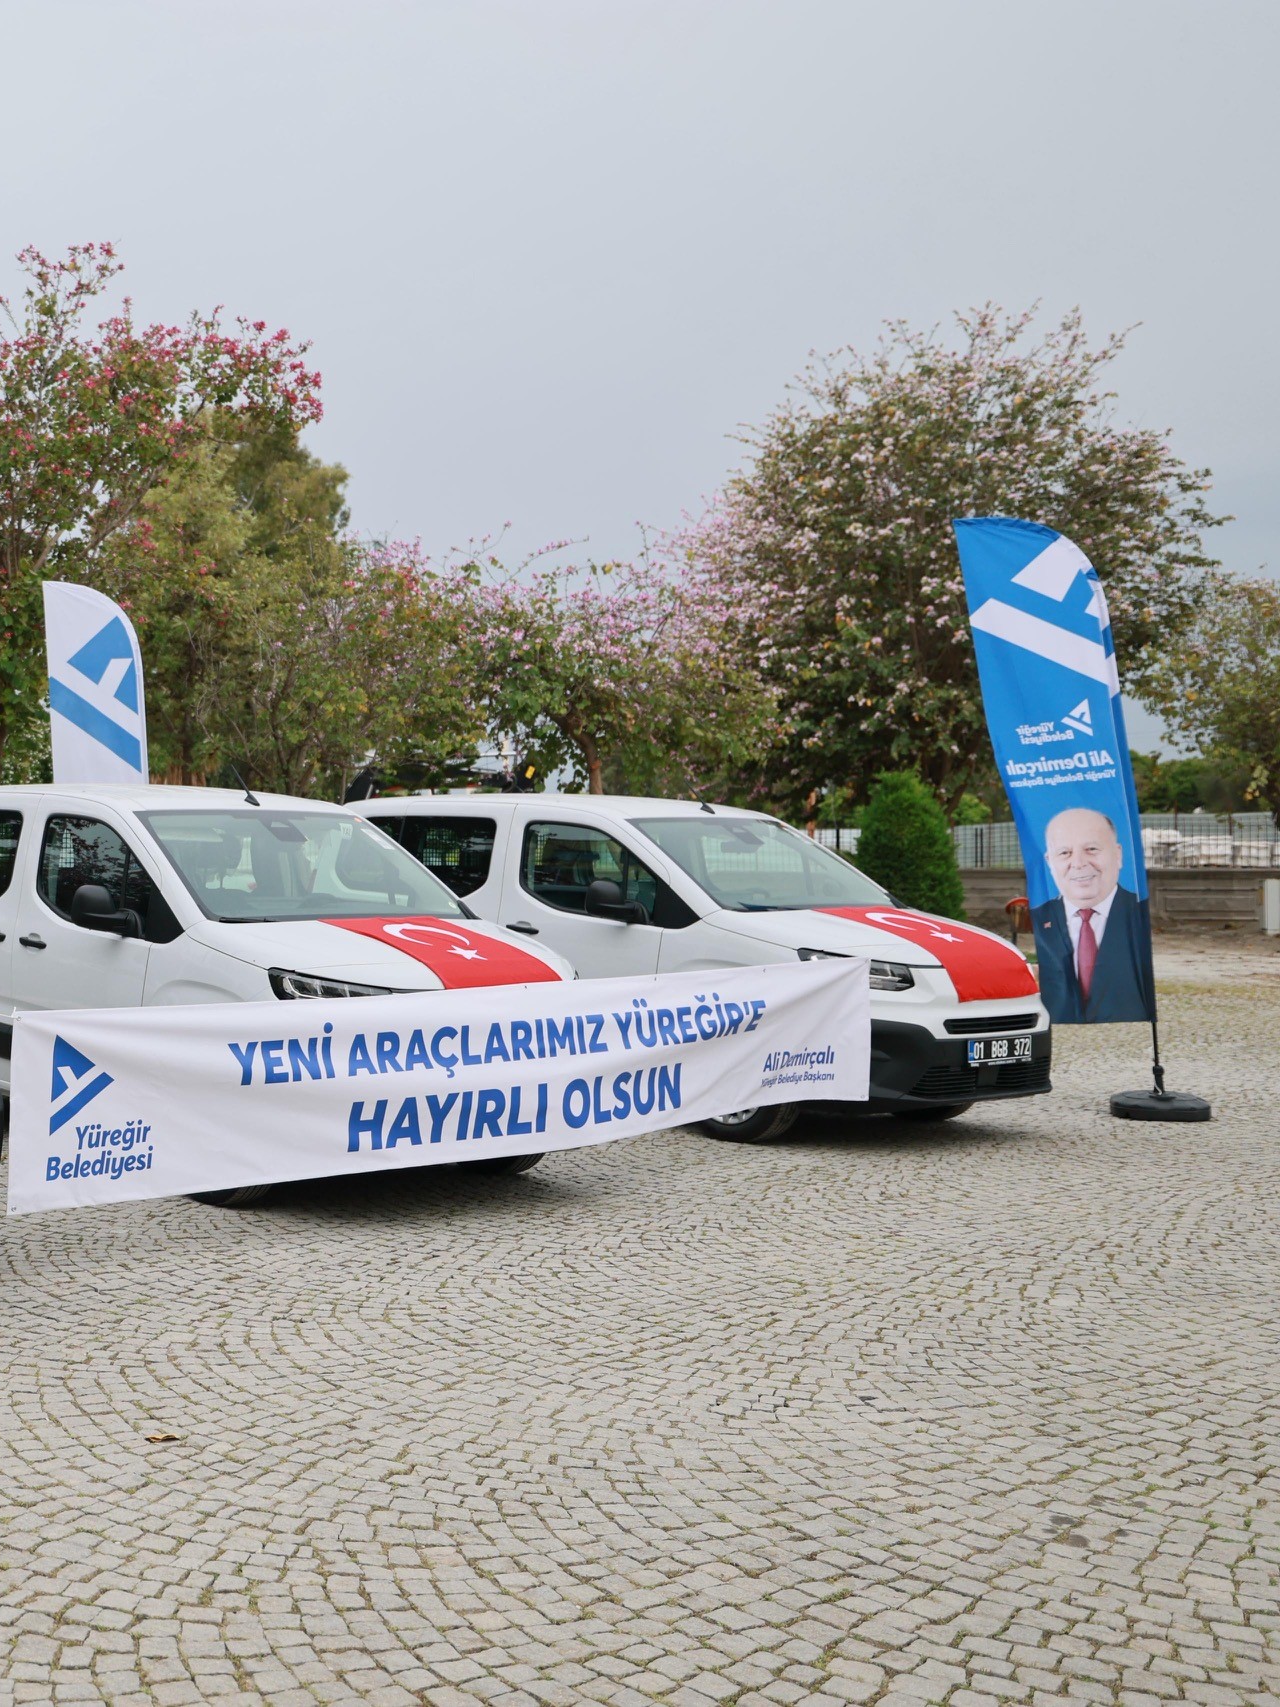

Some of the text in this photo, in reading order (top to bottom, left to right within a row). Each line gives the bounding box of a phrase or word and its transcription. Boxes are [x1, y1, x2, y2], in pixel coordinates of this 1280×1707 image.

[227, 992, 767, 1086] YENİ ARAÇLARIMIZ YÜREĞİR'E
[973, 1038, 1030, 1059] 01 BGB 372
[763, 1045, 835, 1072] Ali Demirçalı
[803, 1070, 835, 1083] Başkanı
[347, 1063, 682, 1153] HAYIRLI OLSUN
[75, 1119, 152, 1151] Yüreğir
[46, 1145, 154, 1181] Belediyesi
